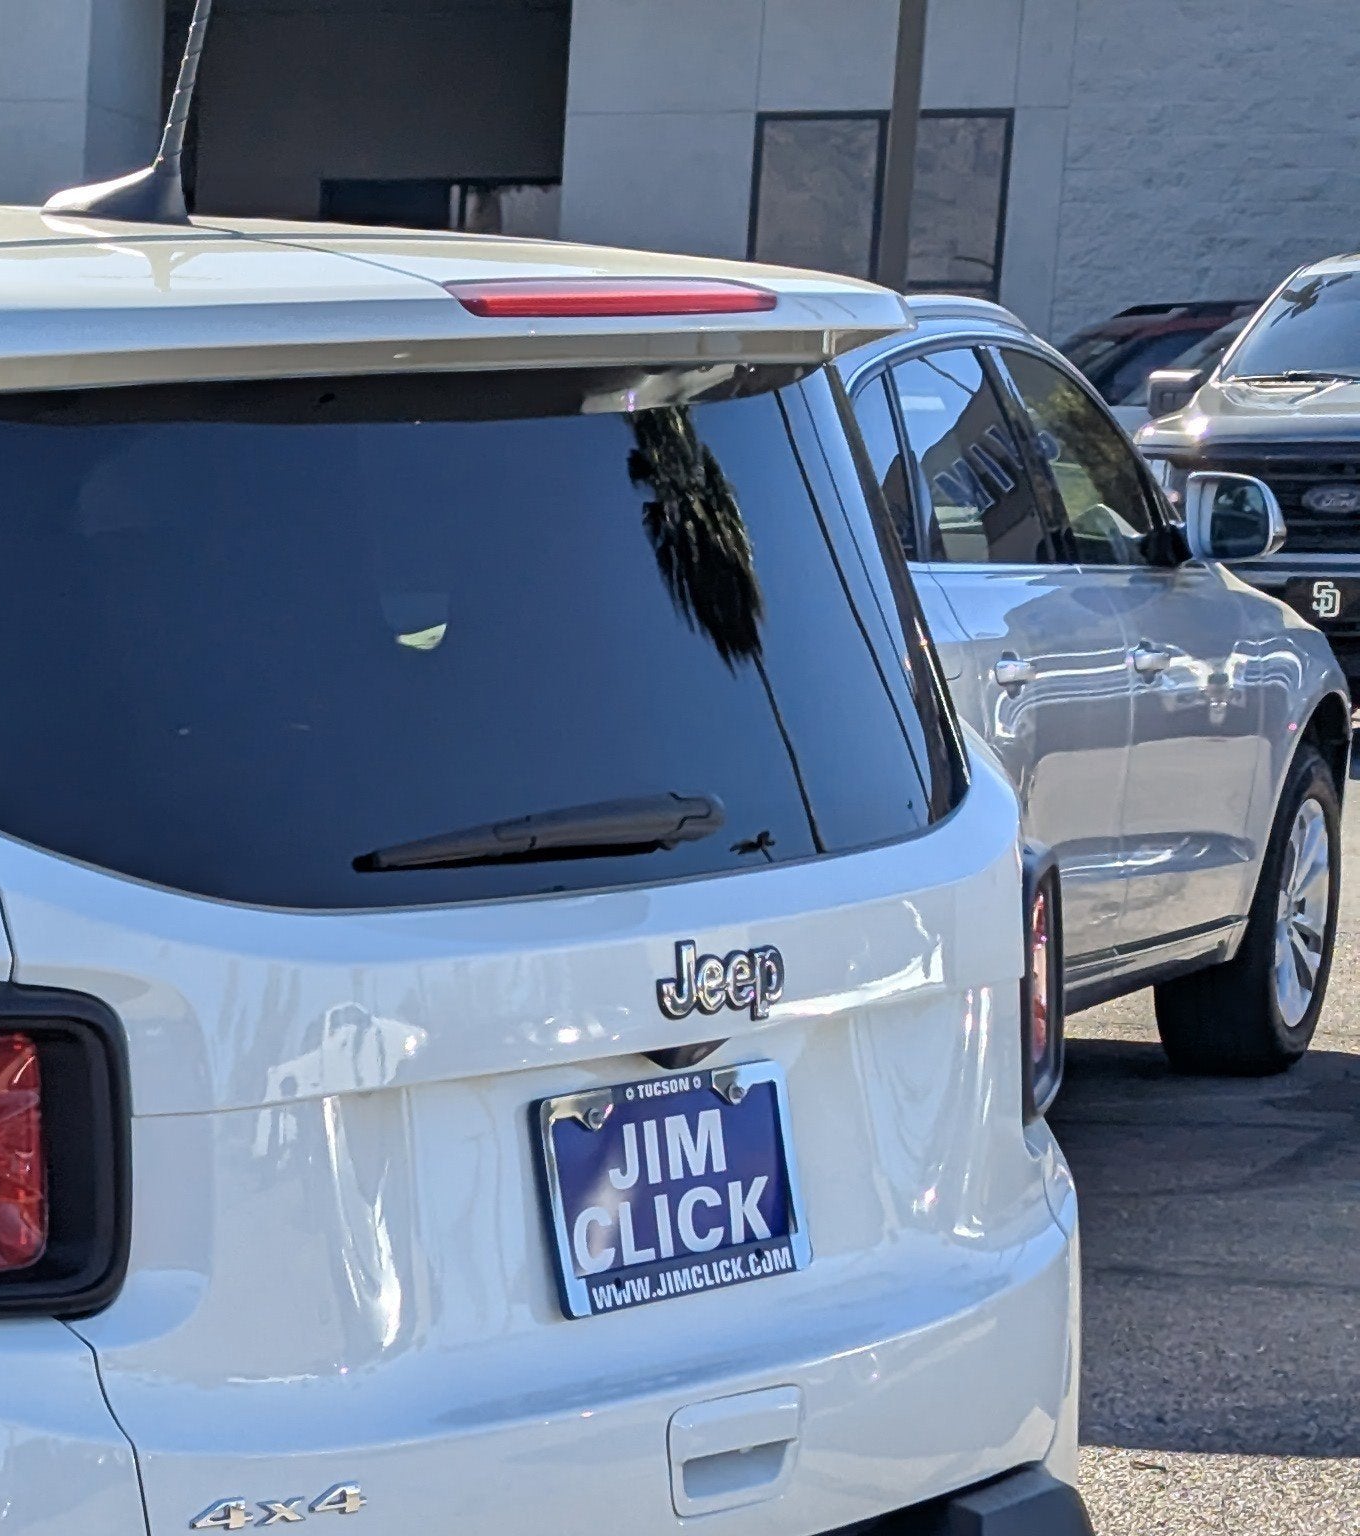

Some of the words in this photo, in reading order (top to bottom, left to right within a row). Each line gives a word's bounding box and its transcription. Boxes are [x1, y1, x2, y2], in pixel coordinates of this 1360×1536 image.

[656, 939, 784, 1021] Jeep
[636, 1077, 690, 1100] TUCSON
[608, 1108, 727, 1190] JIM
[573, 1175, 772, 1275] CLICK
[591, 1246, 793, 1310] WWW.JIMCLICK.COM
[189, 1480, 368, 1530] 4x4
